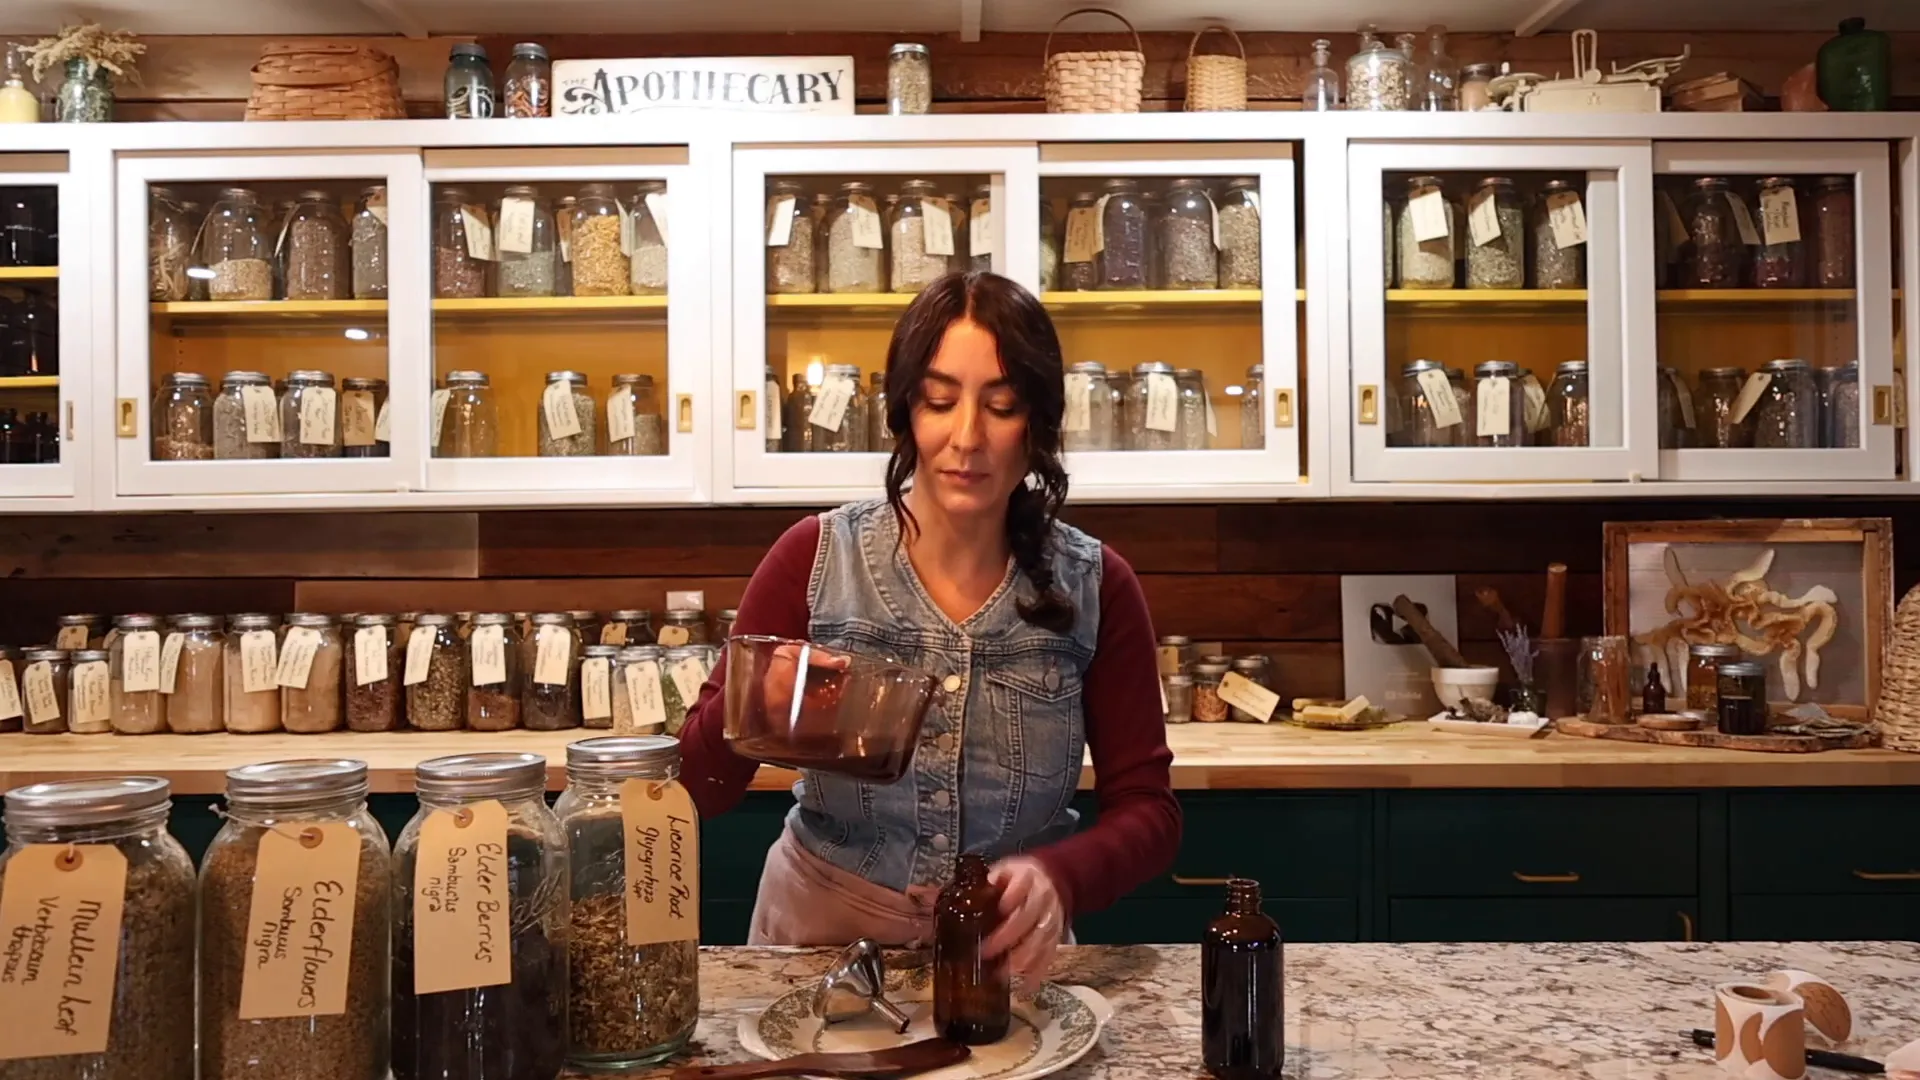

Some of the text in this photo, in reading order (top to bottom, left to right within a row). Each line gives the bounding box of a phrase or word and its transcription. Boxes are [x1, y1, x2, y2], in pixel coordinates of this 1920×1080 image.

[561, 67, 845, 114] APOTHECARY
[421, 876, 442, 913] nigra
[445, 846, 468, 914] Sambucus
[474, 842, 503, 964] Elder Berries
[667, 814, 690, 919] Licorice Root
[253, 920, 278, 970] nigra
[273, 885, 304, 960] Sambucus
[297, 879, 345, 1009] Elderflowers
[53, 899, 102, 1036] Mullein Leaf
